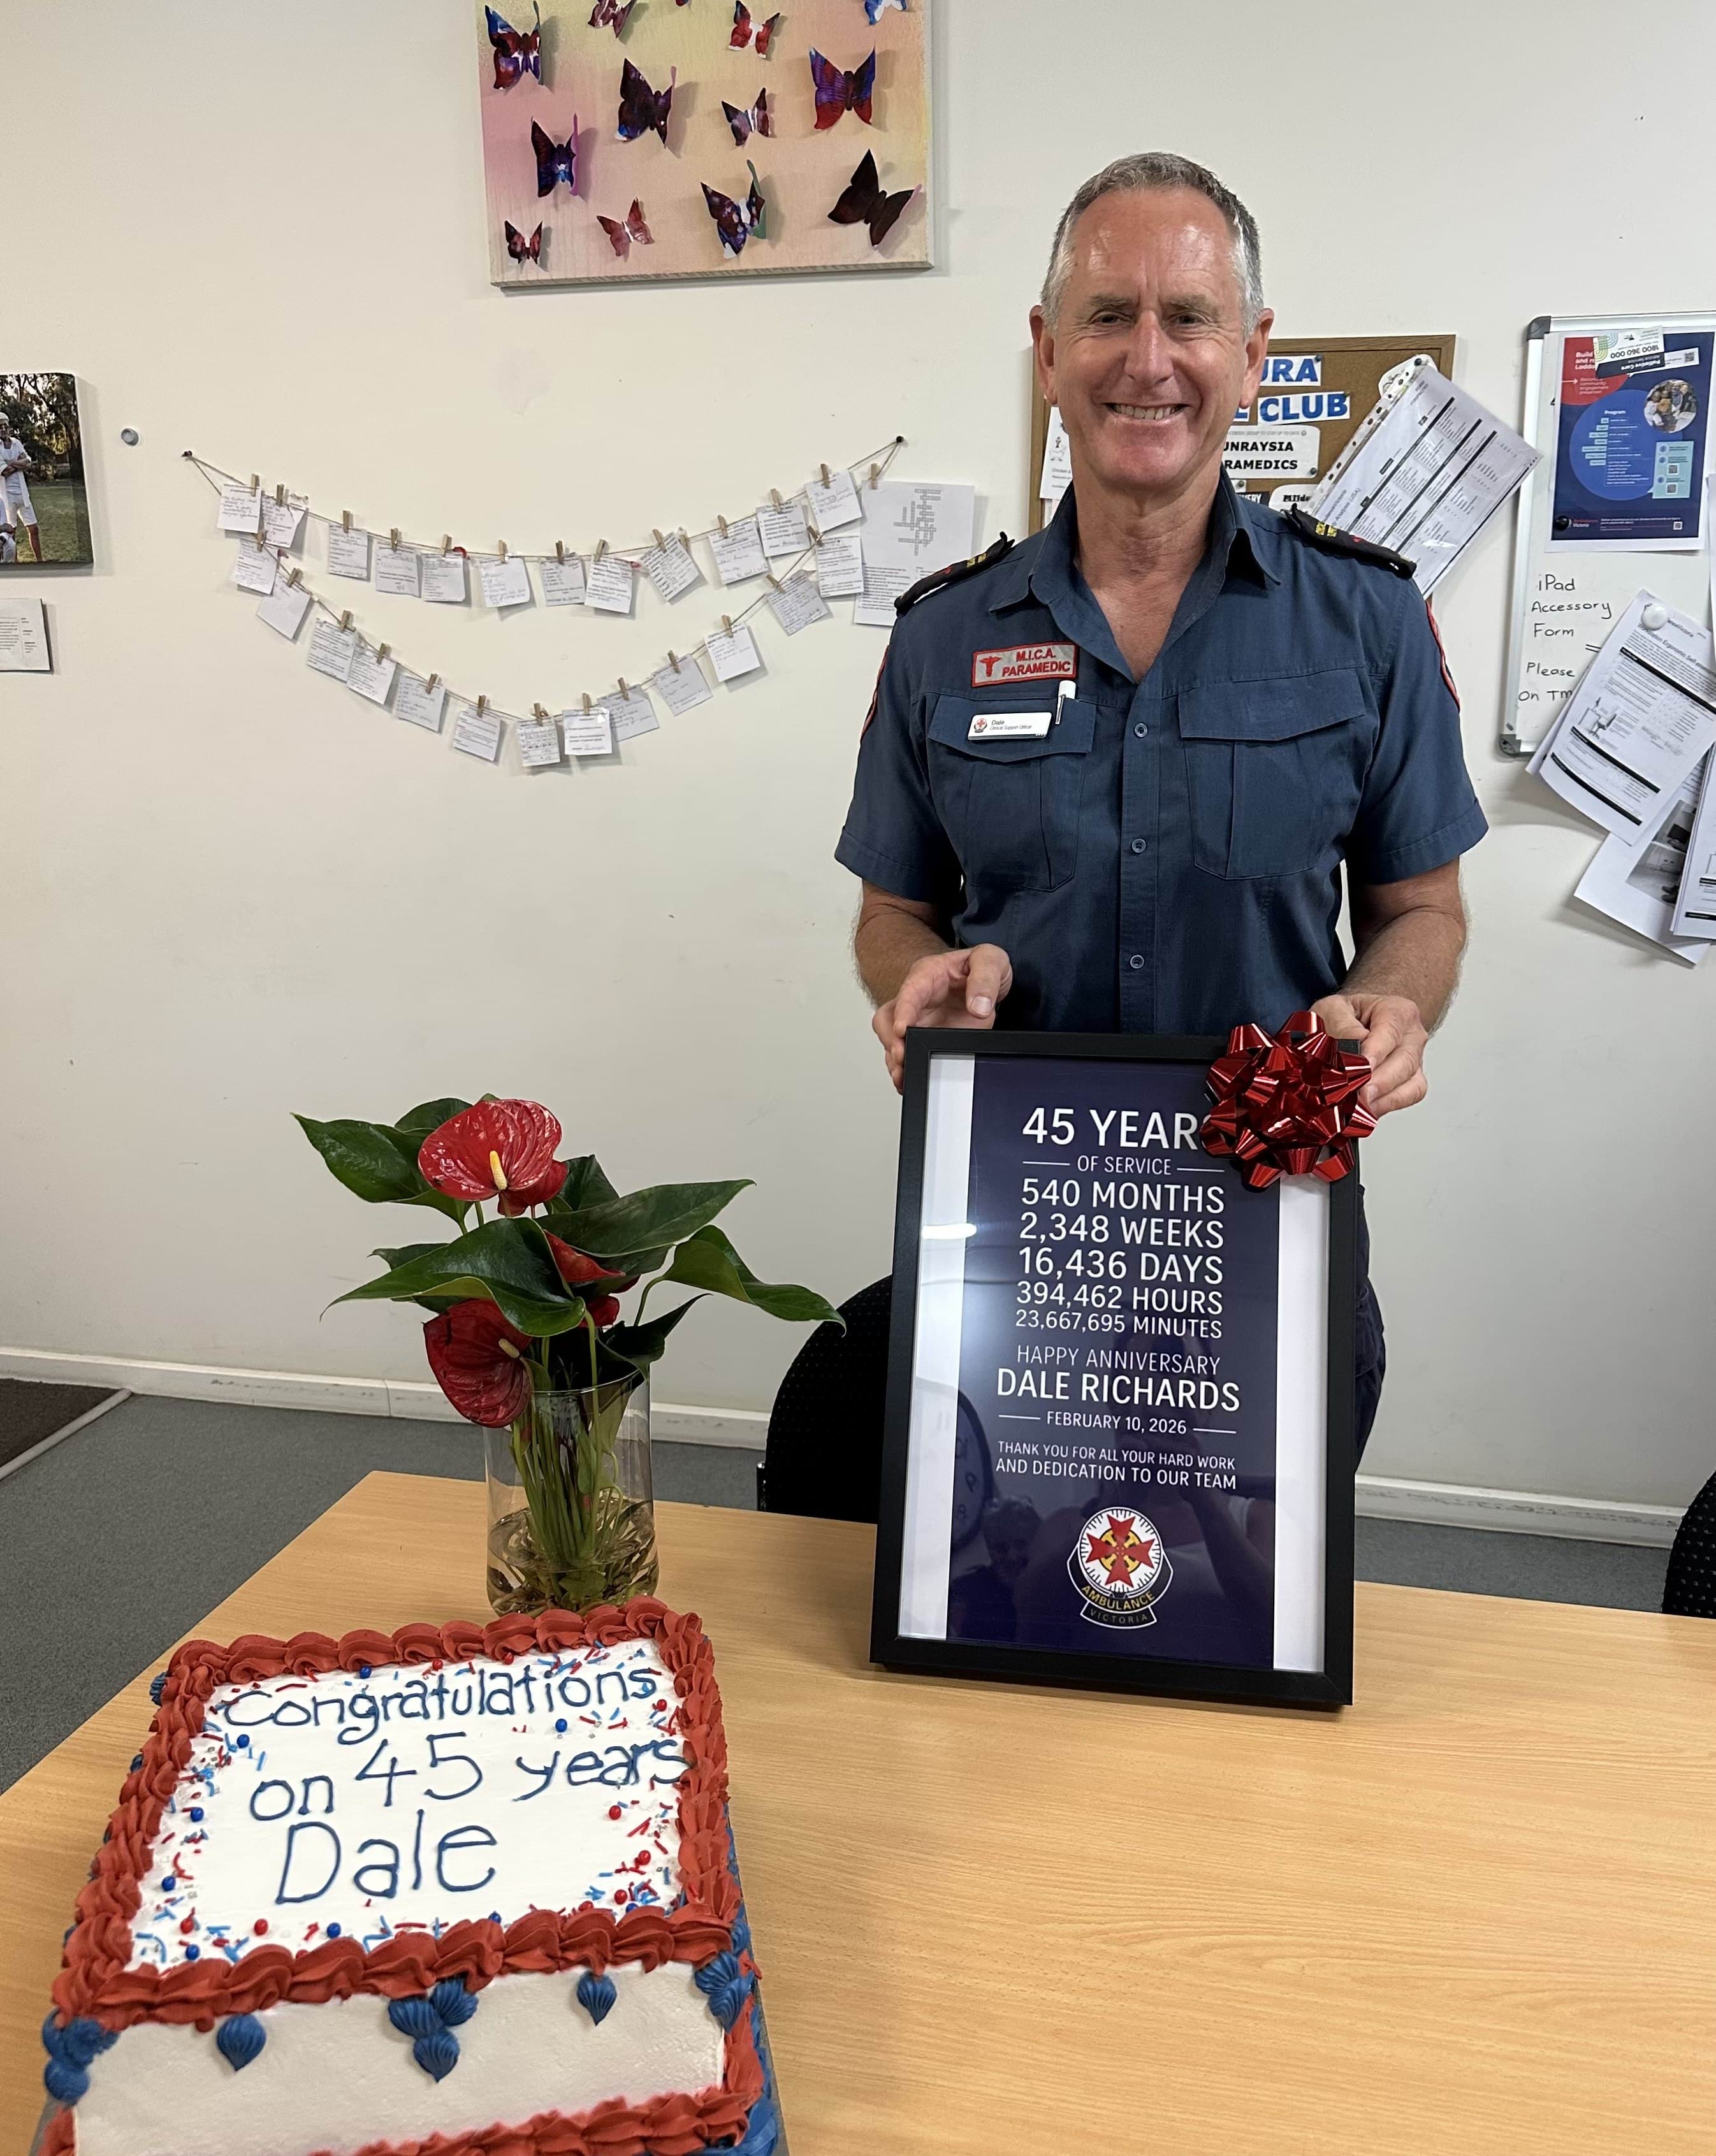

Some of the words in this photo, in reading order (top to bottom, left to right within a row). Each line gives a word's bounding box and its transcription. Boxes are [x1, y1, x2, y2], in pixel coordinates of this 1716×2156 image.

[1260, 393, 1348, 423] CLUB
[1538, 574, 1575, 591] iPad
[1532, 601, 1611, 619] Accessory
[1534, 623, 1574, 637] Form
[1002, 661, 1071, 677] PARAMEDIC
[1016, 648, 1056, 662] M.I.C.A.
[1527, 662, 1575, 677] Please
[1022, 1107, 1075, 1145] 45
[1089, 1109, 1211, 1150] YEAR
[1077, 1155, 1098, 1171] OF
[1104, 1156, 1171, 1175] SERVICE
[1022, 1178, 1080, 1207] 540
[1093, 1181, 1224, 1214] MONTHS
[1019, 1212, 1109, 1244] 2,348
[1120, 1216, 1223, 1248] WEEKS
[1019, 1247, 1127, 1279] 16,436
[1140, 1252, 1223, 1285] DAYS
[1016, 1280, 1123, 1309] 394,462
[1133, 1287, 1223, 1315] HOURS
[1015, 1309, 1125, 1333] 23,667,695
[1133, 1315, 1222, 1339] MINUTES
[1017, 1344, 1079, 1366] HAPPY
[1086, 1349, 1221, 1375] ANNIVERSARY
[997, 1368, 1070, 1400] DALE
[1081, 1373, 1240, 1412] RICHARDS
[1047, 1411, 1121, 1429] FEBRUARY
[1125, 1416, 1145, 1433] 10,
[1149, 1418, 1187, 1435] 2026
[998, 1441, 1039, 1456] THANK
[1043, 1444, 1068, 1458] YOU
[1072, 1446, 1096, 1459] FOR
[1098, 1448, 1119, 1461] ALL
[1121, 1449, 1155, 1464] YOUR
[1159, 1452, 1193, 1467] HARD
[1197, 1455, 1235, 1470] WORK
[996, 1458, 1028, 1473] AND
[1033, 1460, 1125, 1481] DEDICATION
[1131, 1467, 1151, 1483] TO
[1157, 1469, 1189, 1486] OUR
[1194, 1472, 1236, 1489] TEAM
[1082, 1585, 1155, 1610] AMBULANCE
[1089, 1607, 1149, 1624] VICTORIA
[224, 1665, 657, 1746] Congratulations
[249, 1774, 336, 1821] on
[355, 1731, 484, 1808] 45
[512, 1737, 694, 1802] years
[275, 1809, 498, 1906] Dale
